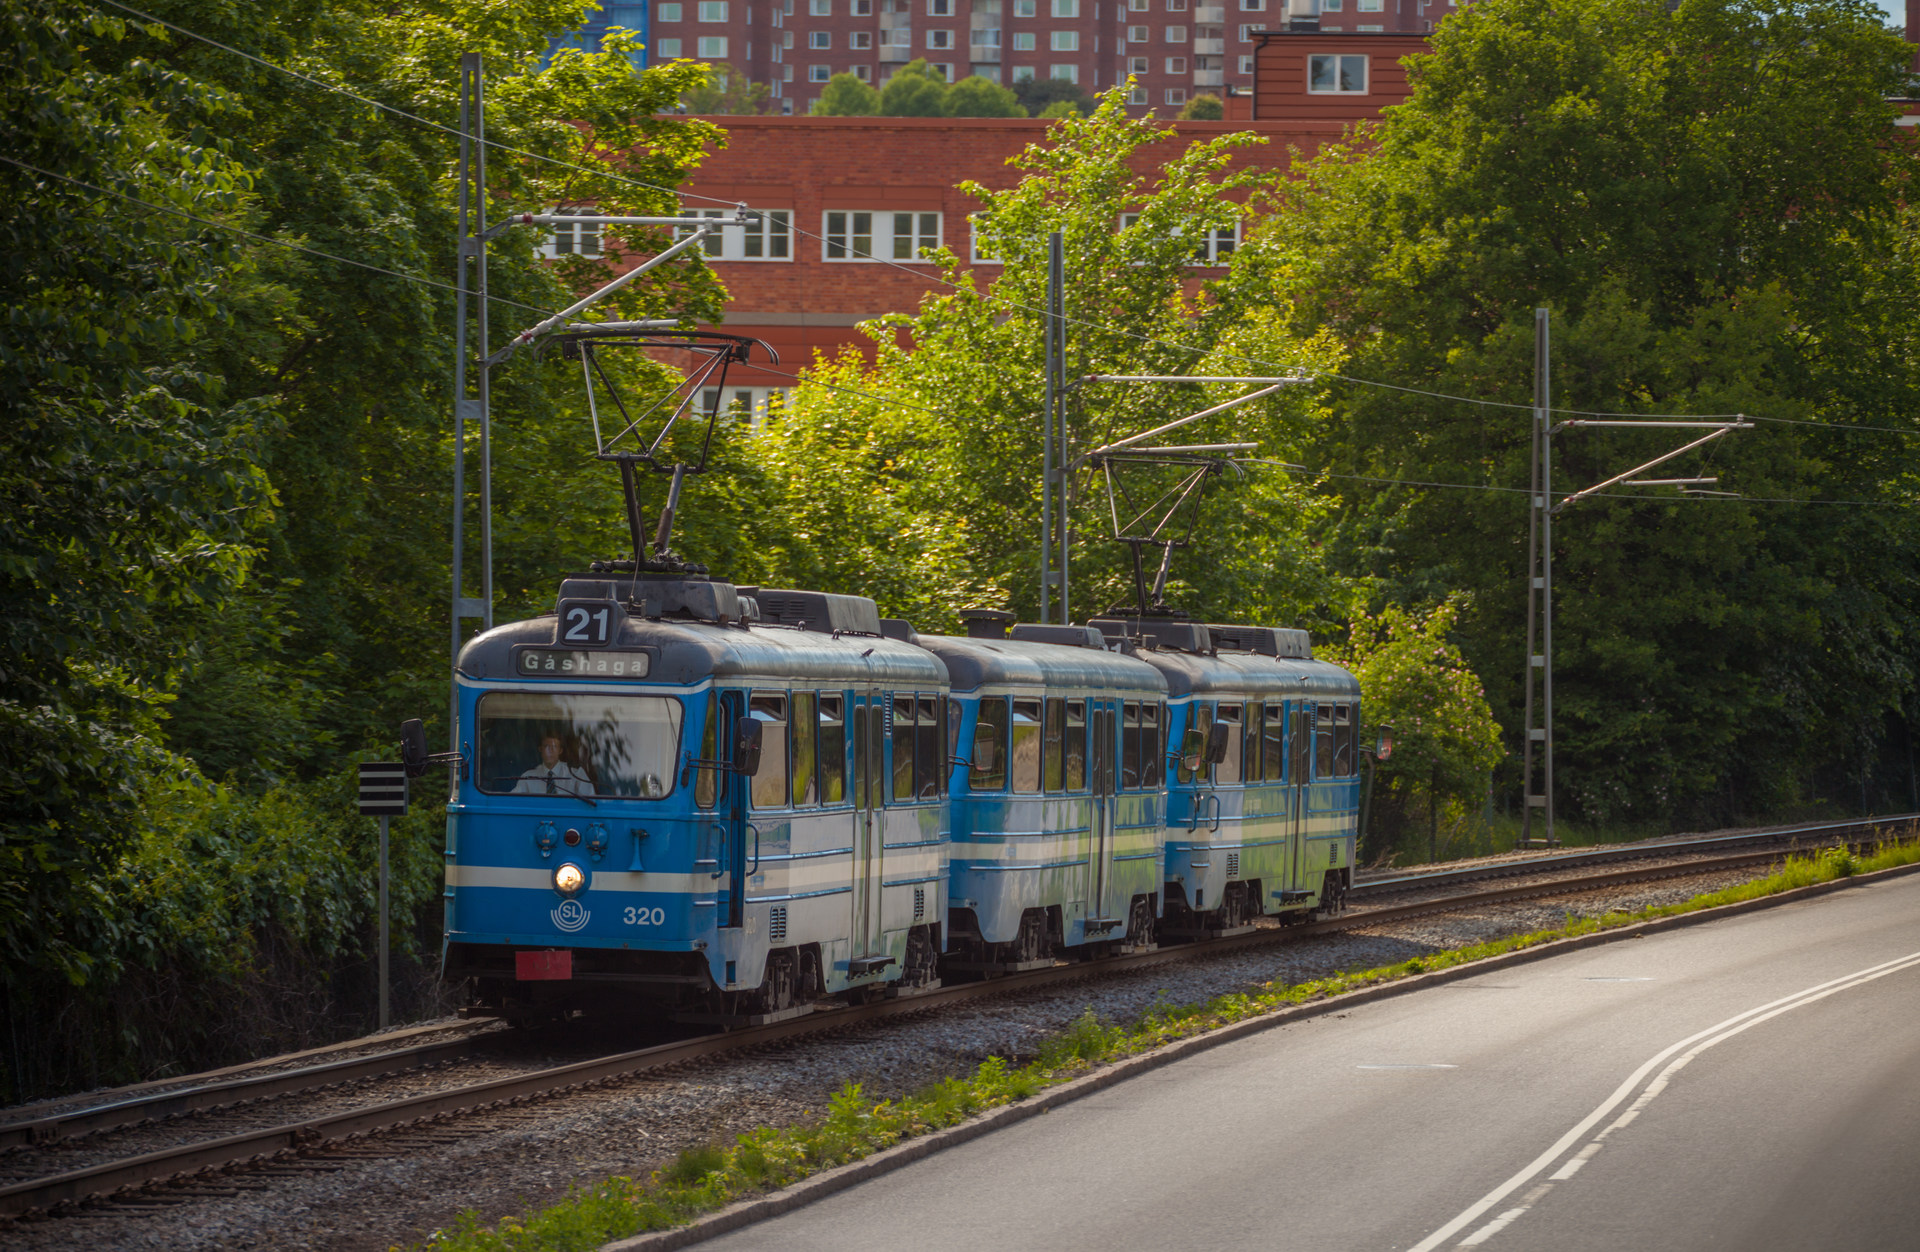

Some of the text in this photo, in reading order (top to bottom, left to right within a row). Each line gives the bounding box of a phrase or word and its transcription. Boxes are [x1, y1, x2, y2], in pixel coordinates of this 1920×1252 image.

[565, 607, 608, 640] 21
[525, 655, 641, 675] Gåshaga
[562, 905, 579, 918] SL
[623, 906, 665, 926] 320
